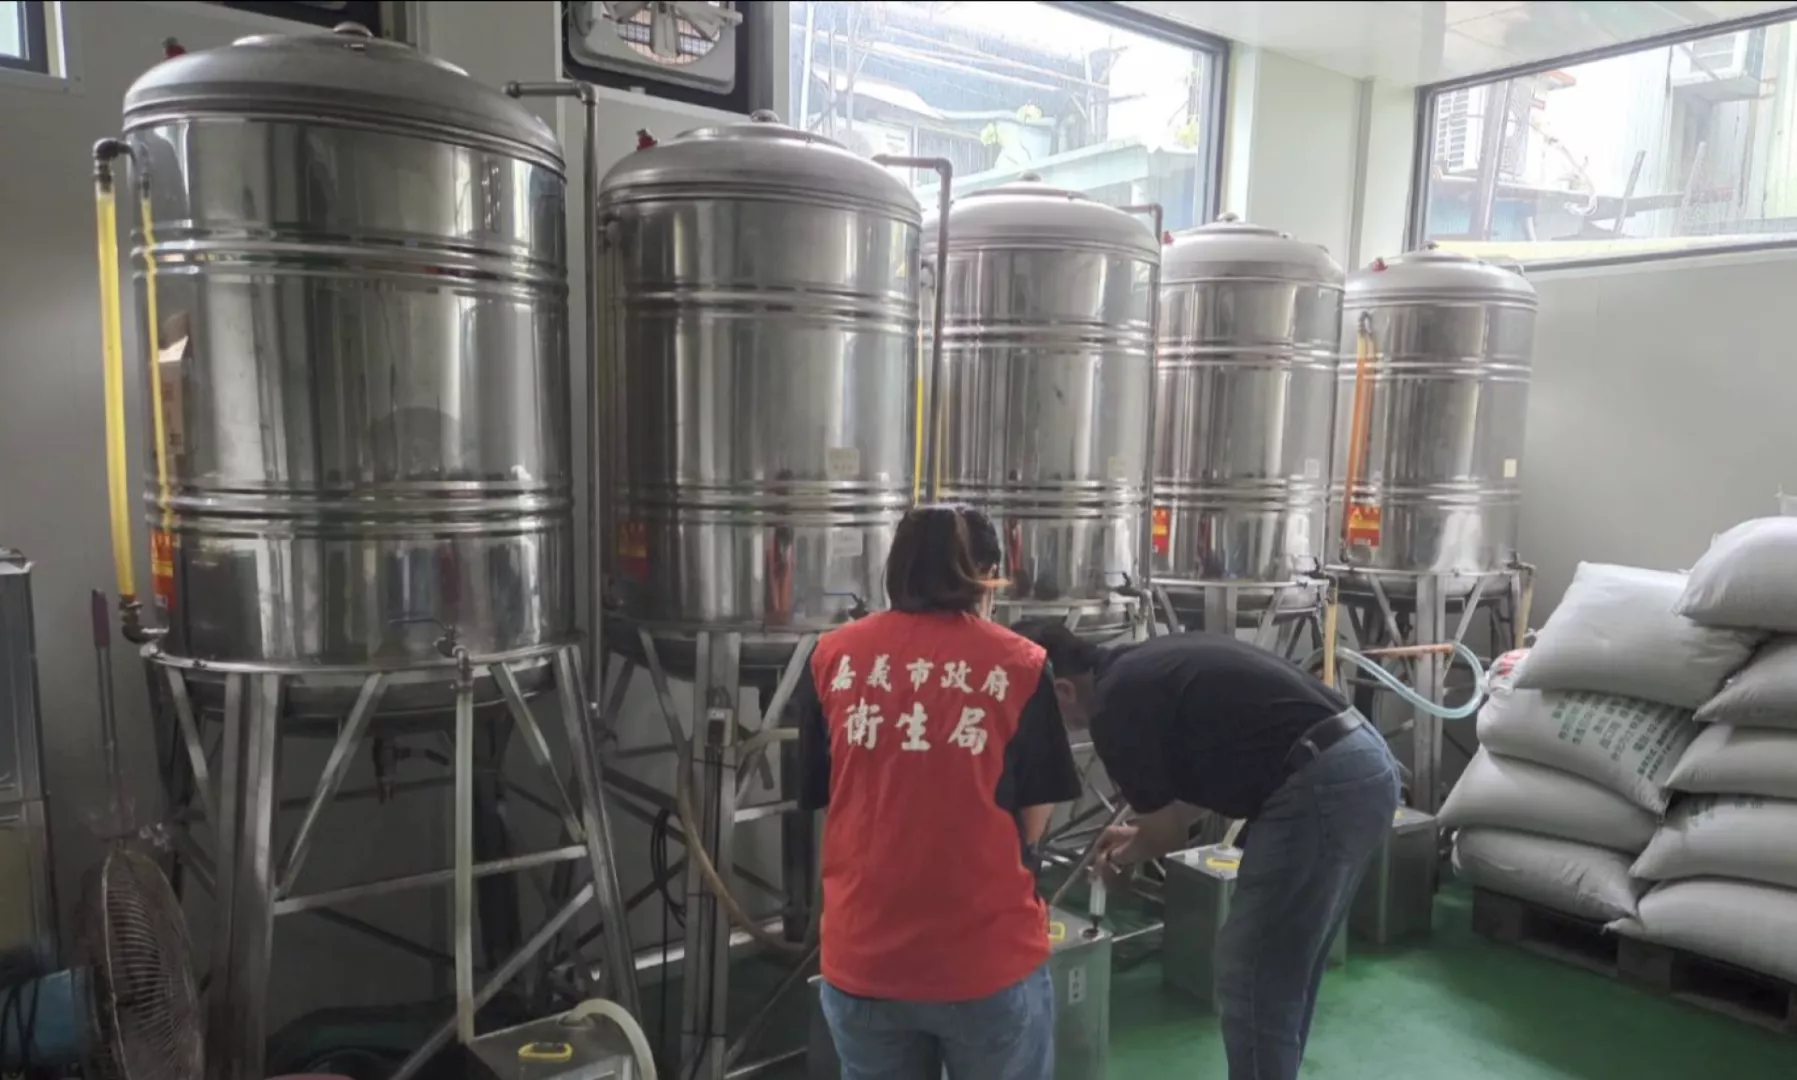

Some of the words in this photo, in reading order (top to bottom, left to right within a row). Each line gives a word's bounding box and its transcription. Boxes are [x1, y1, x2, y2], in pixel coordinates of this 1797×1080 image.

[831, 654, 1009, 702] 嘉義市政府
[844, 697, 988, 756] 衛生局
